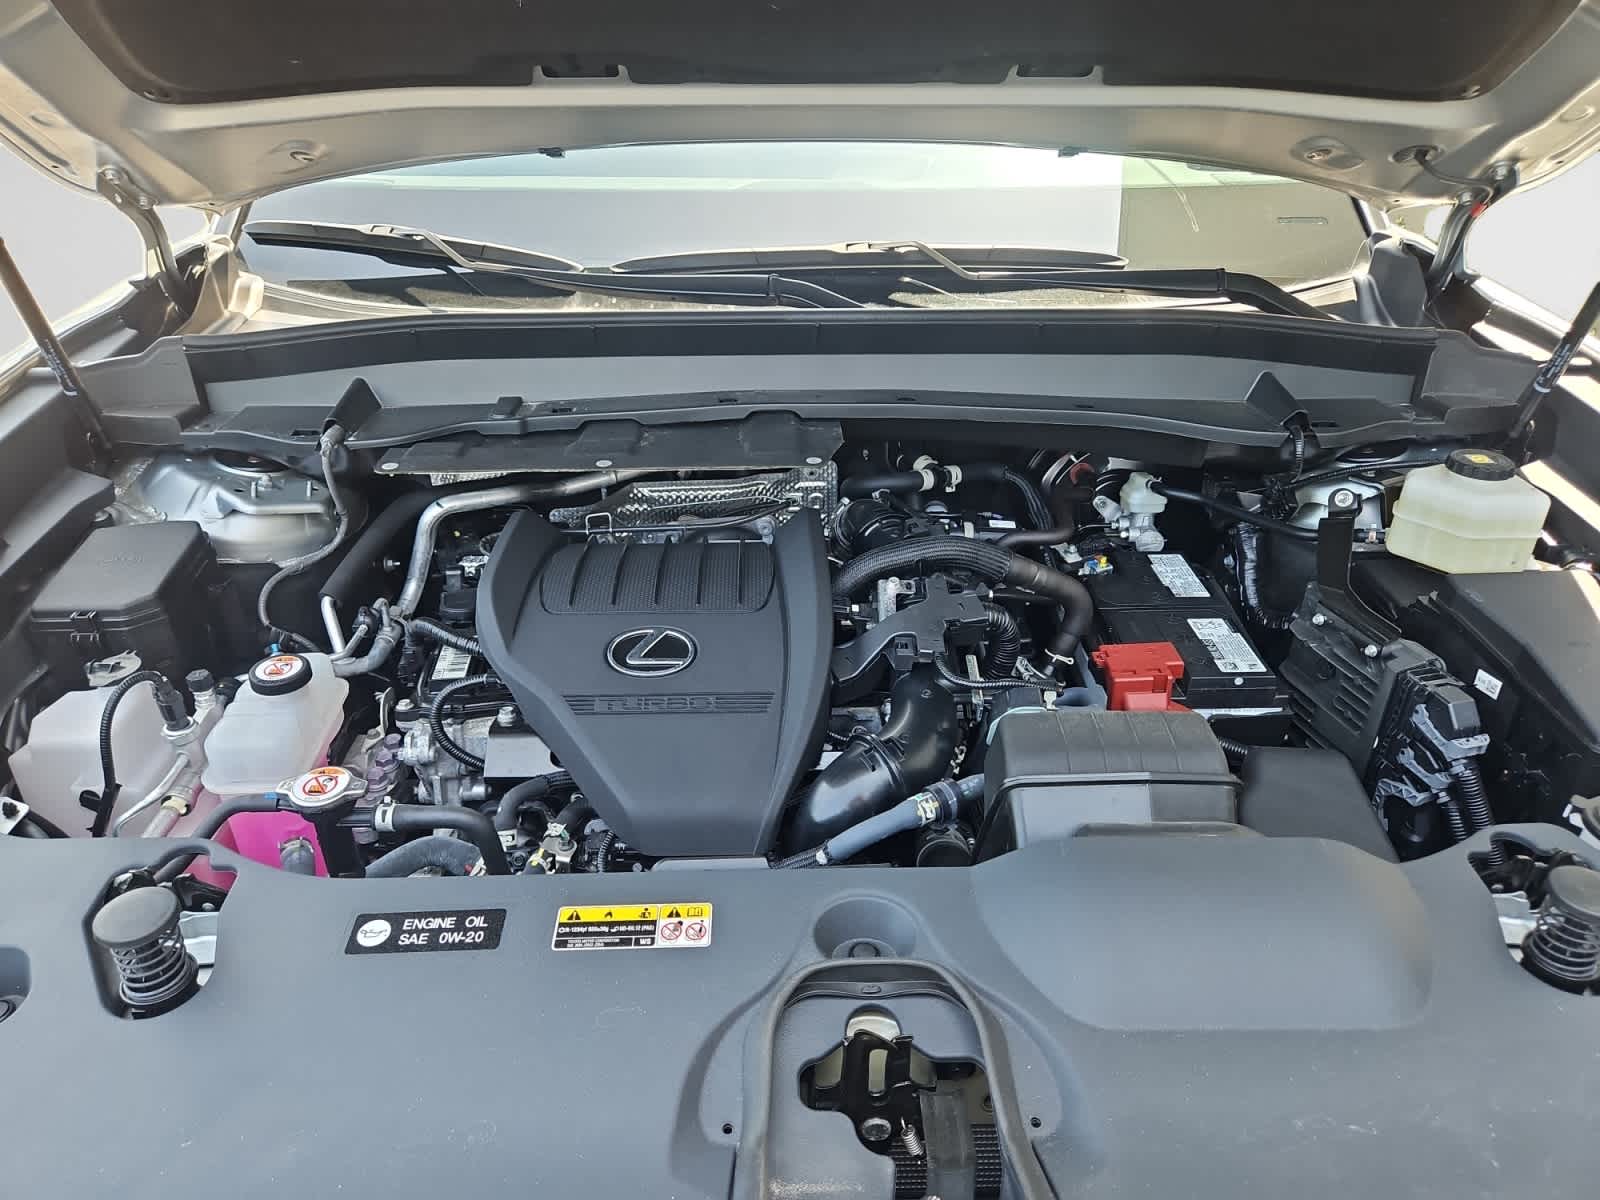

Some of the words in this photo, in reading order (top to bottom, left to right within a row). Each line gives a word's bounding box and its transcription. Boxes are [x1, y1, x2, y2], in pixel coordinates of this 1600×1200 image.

[598, 695, 715, 712] TURBO
[402, 916, 456, 930] ENGINE
[465, 915, 488, 928] OIL
[398, 933, 429, 945] SAE
[438, 931, 484, 944] 0W-20
